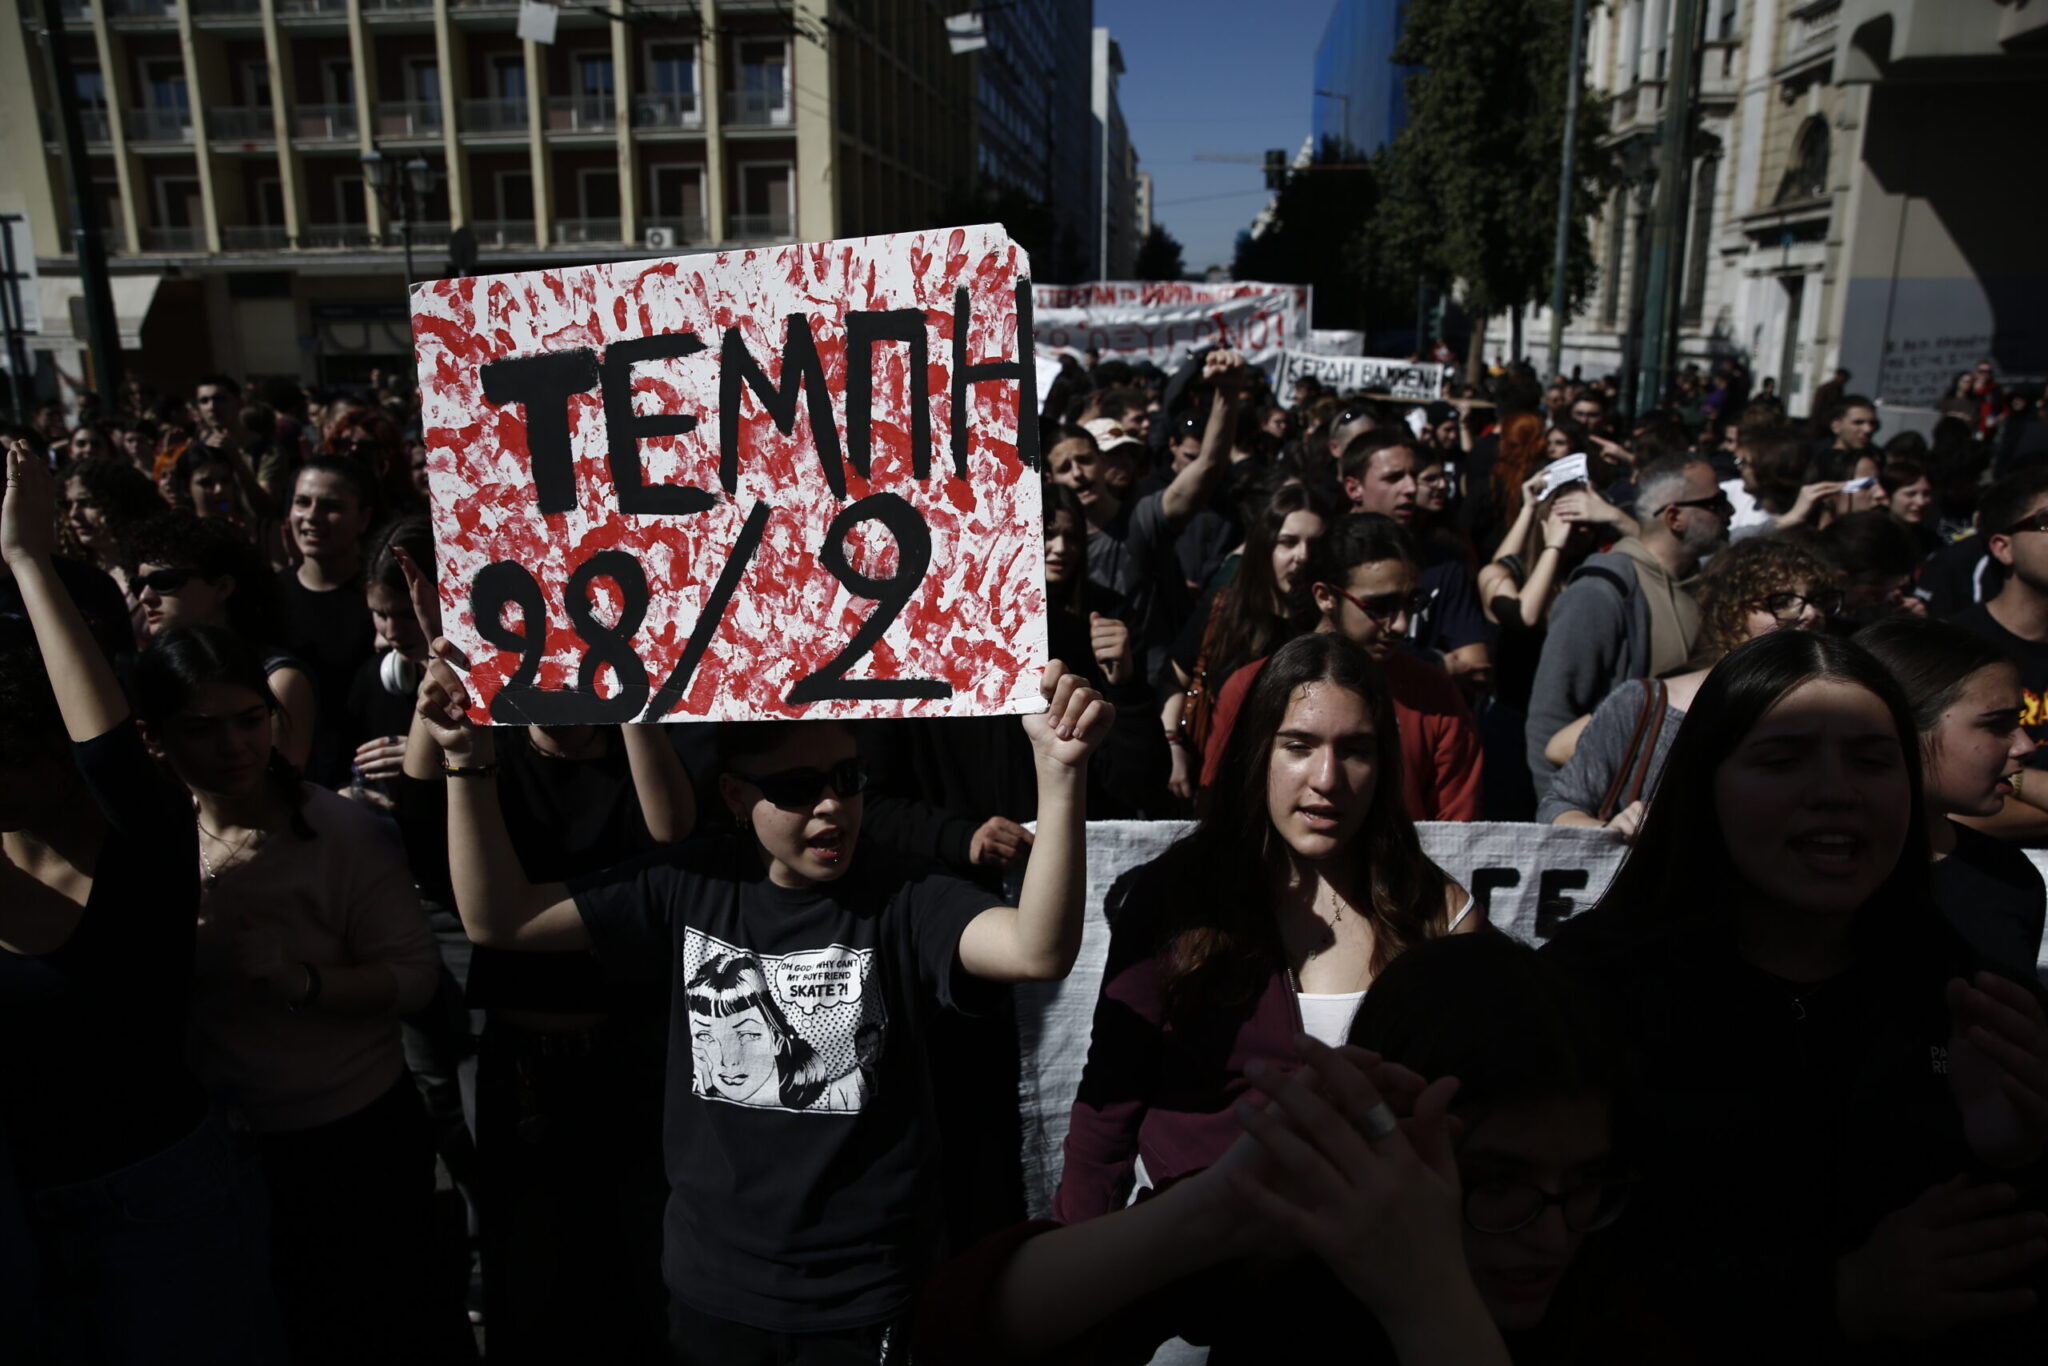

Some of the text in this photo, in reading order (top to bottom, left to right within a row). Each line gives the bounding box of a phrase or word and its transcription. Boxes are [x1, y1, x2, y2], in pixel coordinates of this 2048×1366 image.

[480, 275, 1040, 515] ΤΕΜΠΗ
[471, 491, 953, 724] 28/2
[781, 962, 793, 971] OH
[816, 960, 835, 969] WHY
[836, 959, 858, 969] CAN'T
[802, 971, 851, 981] BOYFRIEND
